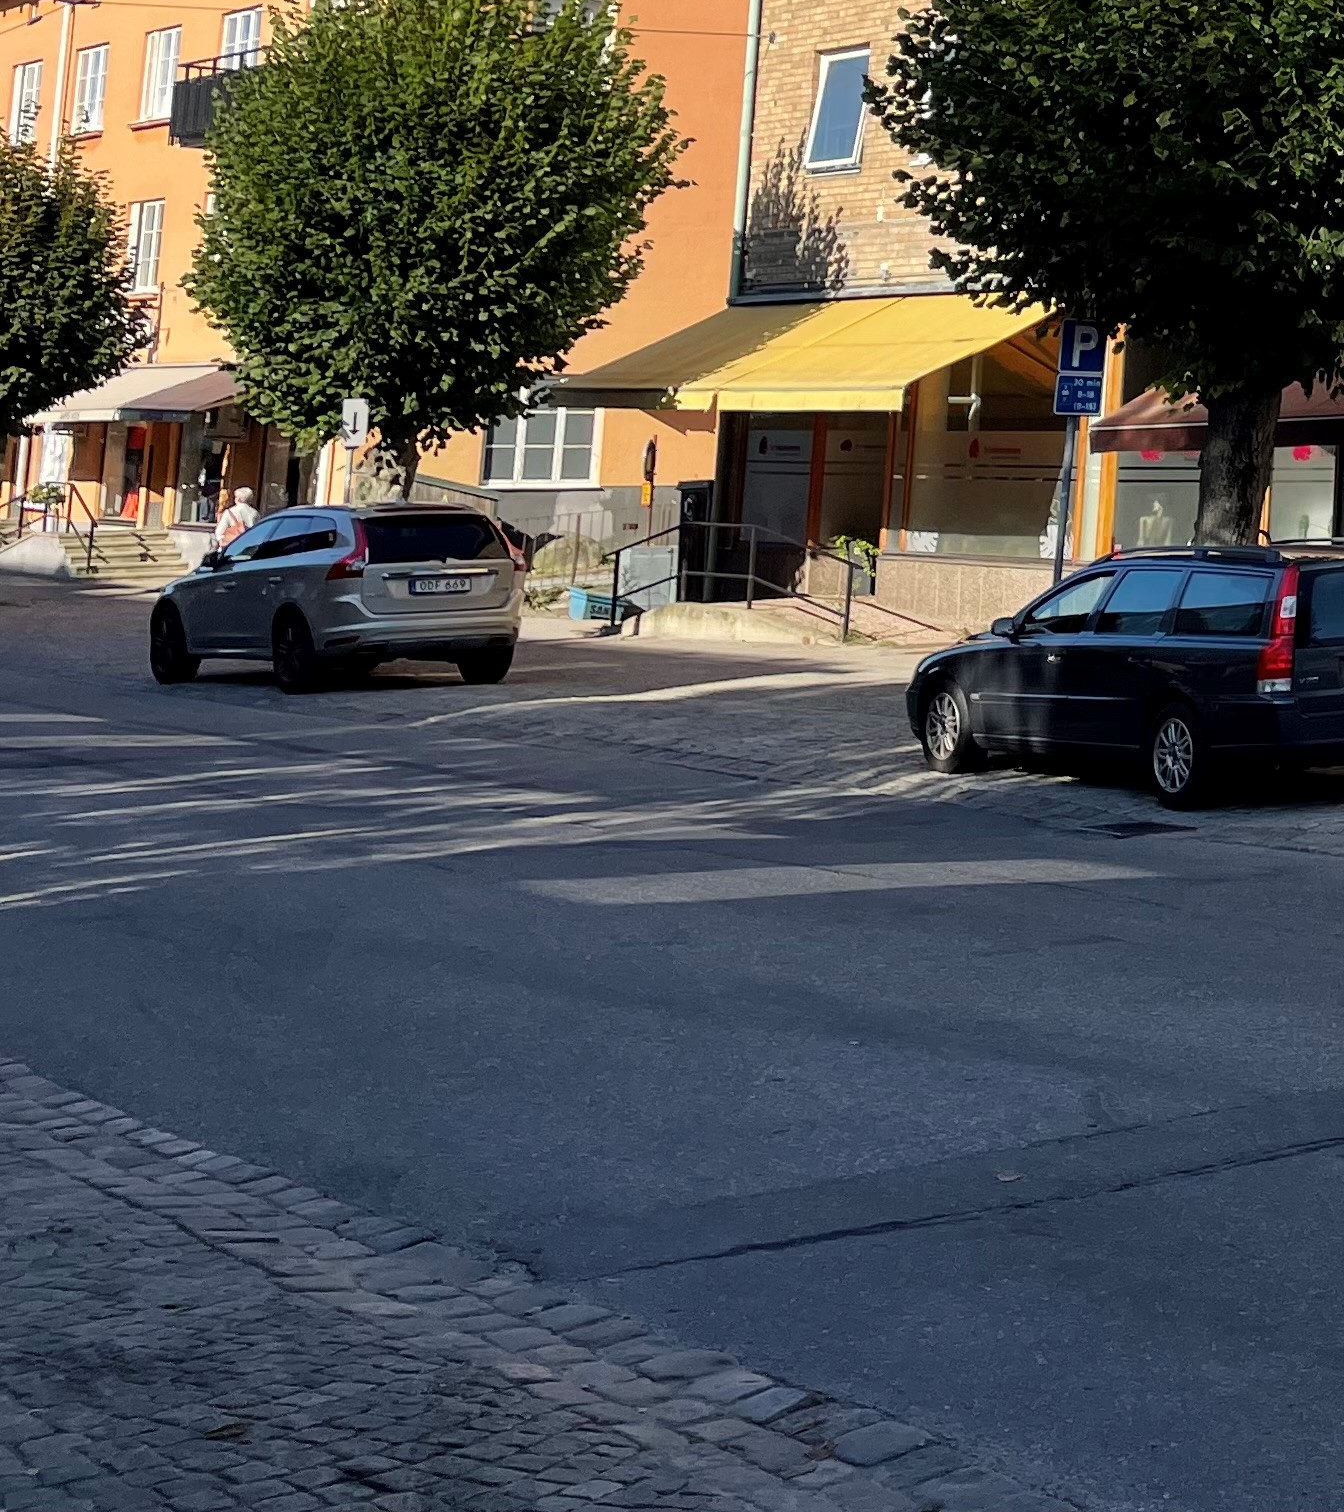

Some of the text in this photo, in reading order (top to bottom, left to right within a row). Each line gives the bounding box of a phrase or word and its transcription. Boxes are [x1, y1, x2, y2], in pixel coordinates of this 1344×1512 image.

[1072, 325, 1099, 368] P
[1086, 378, 1101, 387] min
[590, 604, 613, 616] SAN
